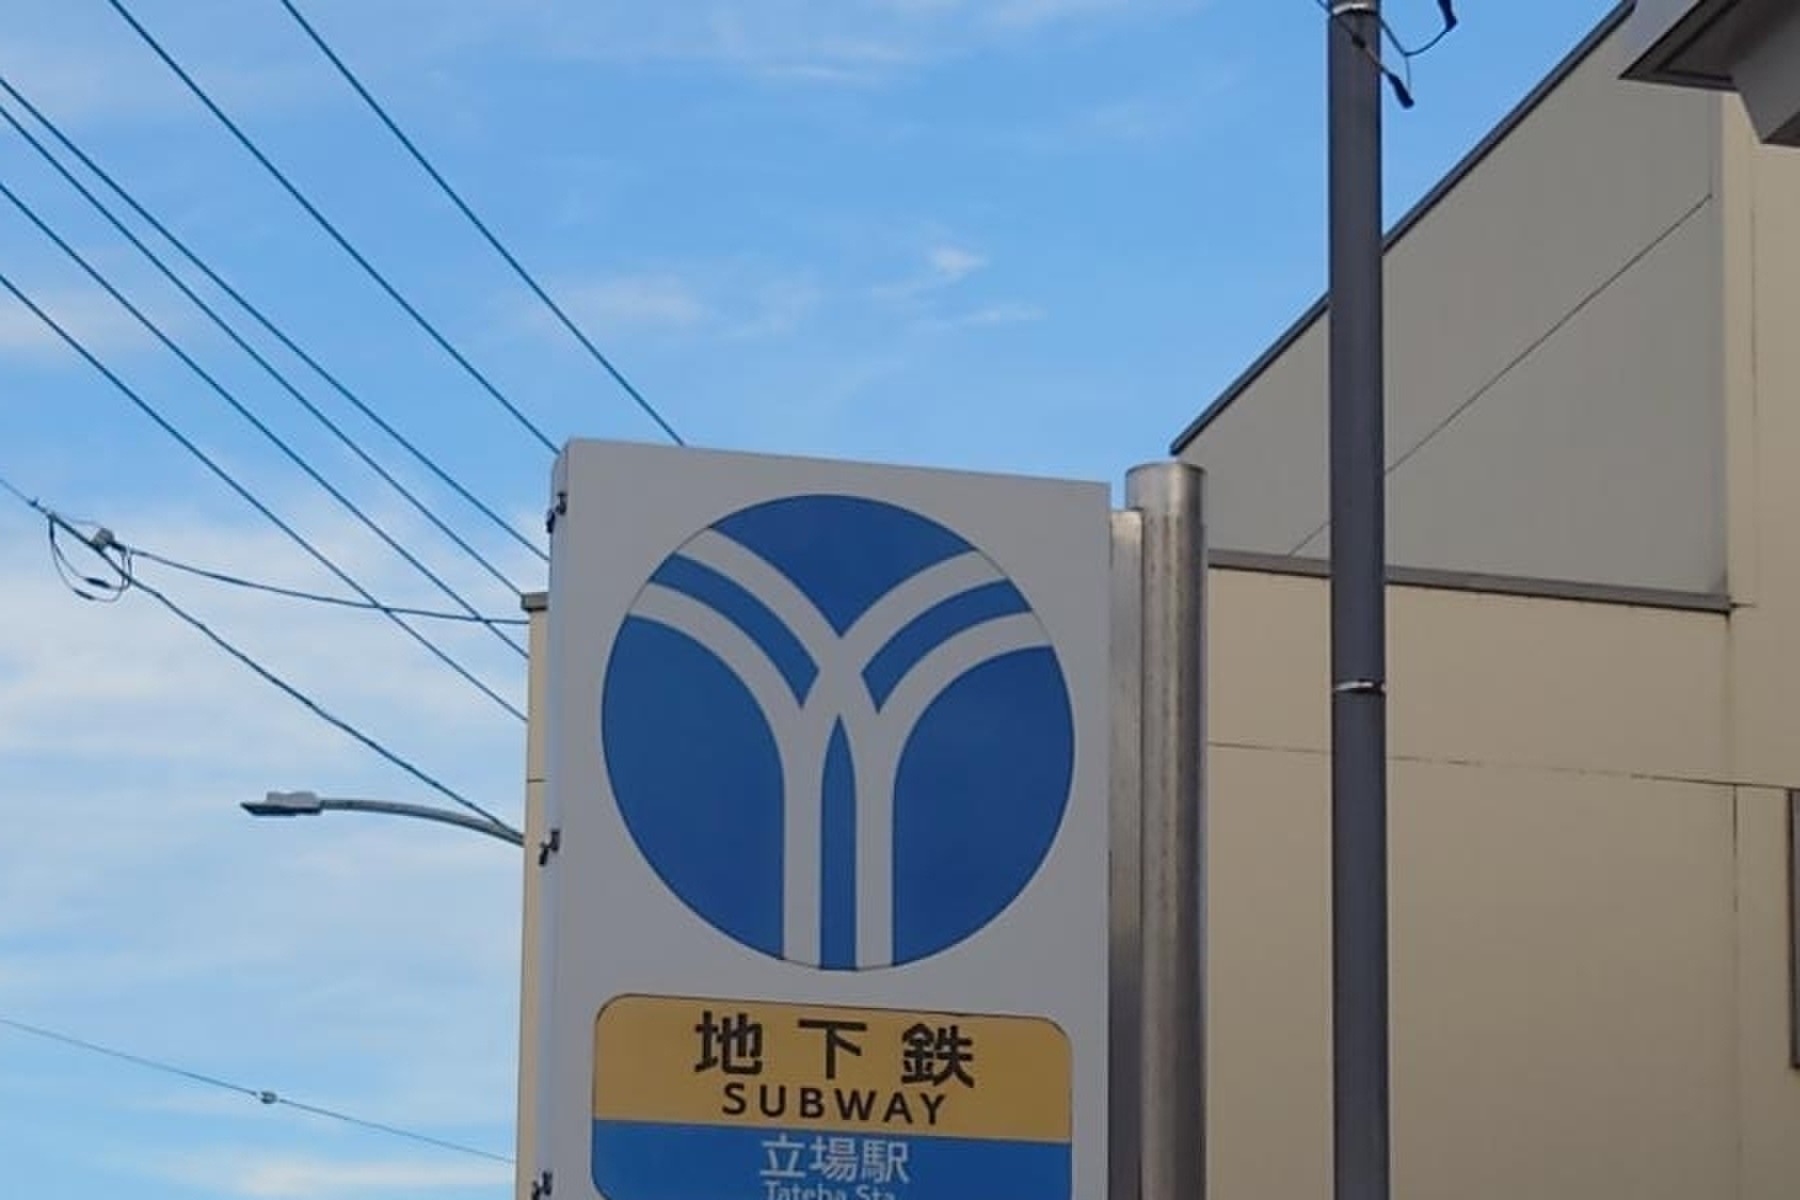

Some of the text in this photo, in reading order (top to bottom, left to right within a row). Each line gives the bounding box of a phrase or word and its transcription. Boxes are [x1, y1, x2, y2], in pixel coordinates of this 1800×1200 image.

[694, 1010, 975, 1088] 地下鉄
[722, 1081, 946, 1125] SUBWAY
[759, 1133, 911, 1184] 立場駅
